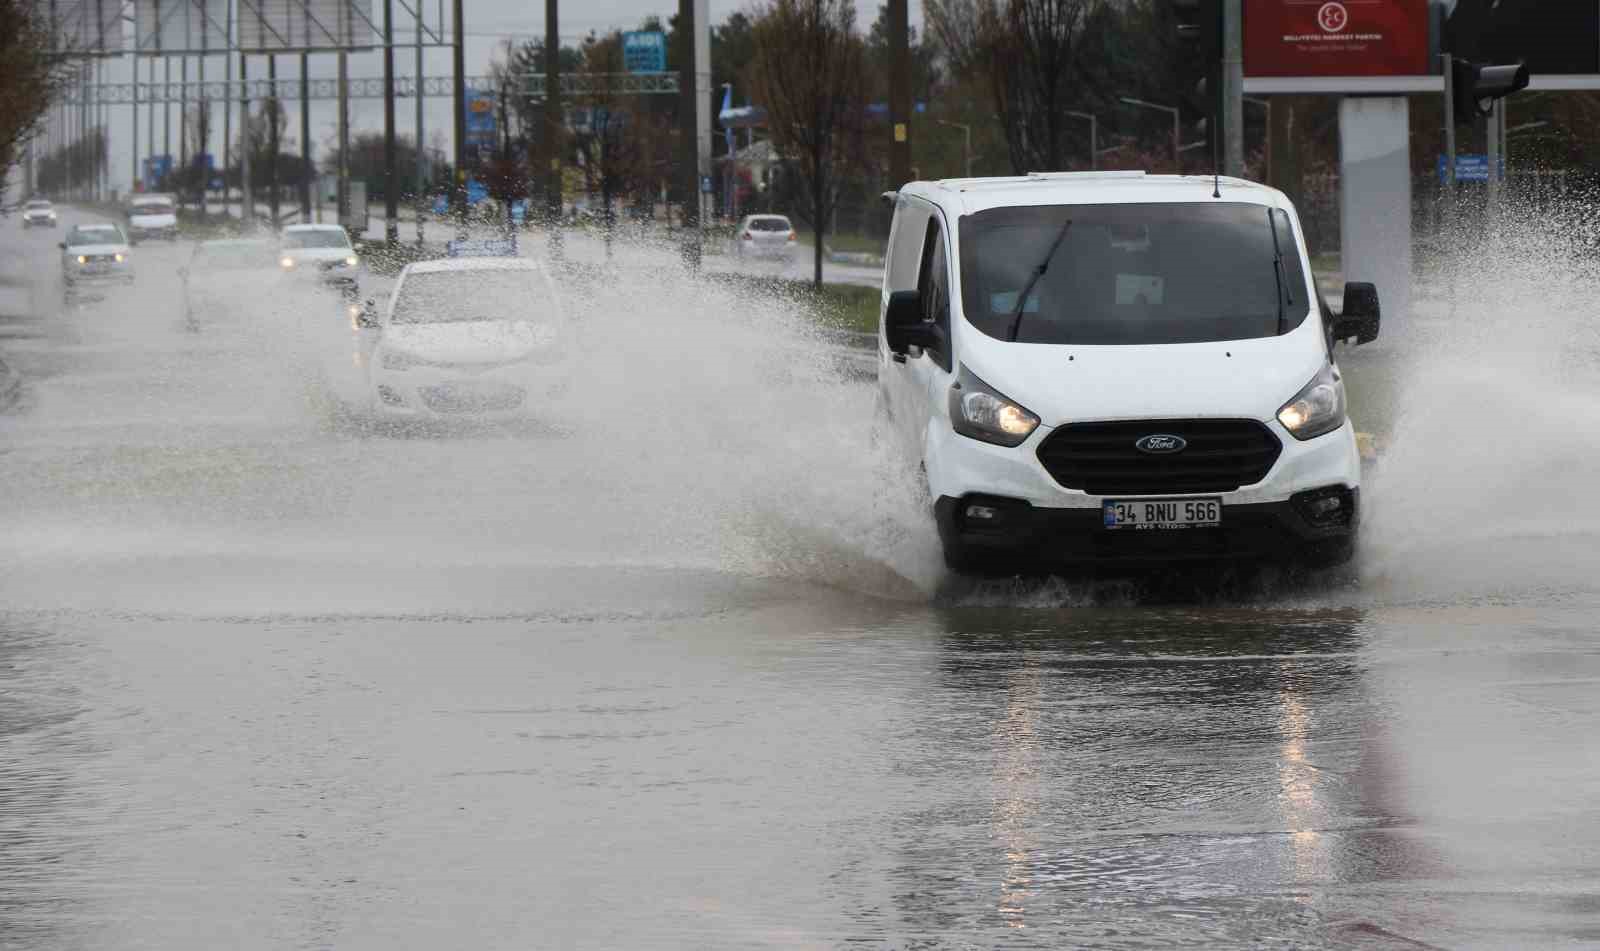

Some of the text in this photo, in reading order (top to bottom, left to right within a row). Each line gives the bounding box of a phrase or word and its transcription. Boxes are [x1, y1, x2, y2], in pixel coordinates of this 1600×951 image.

[1148, 437, 1176, 449] Ford
[1117, 502, 1217, 522] 34 BNU 566
